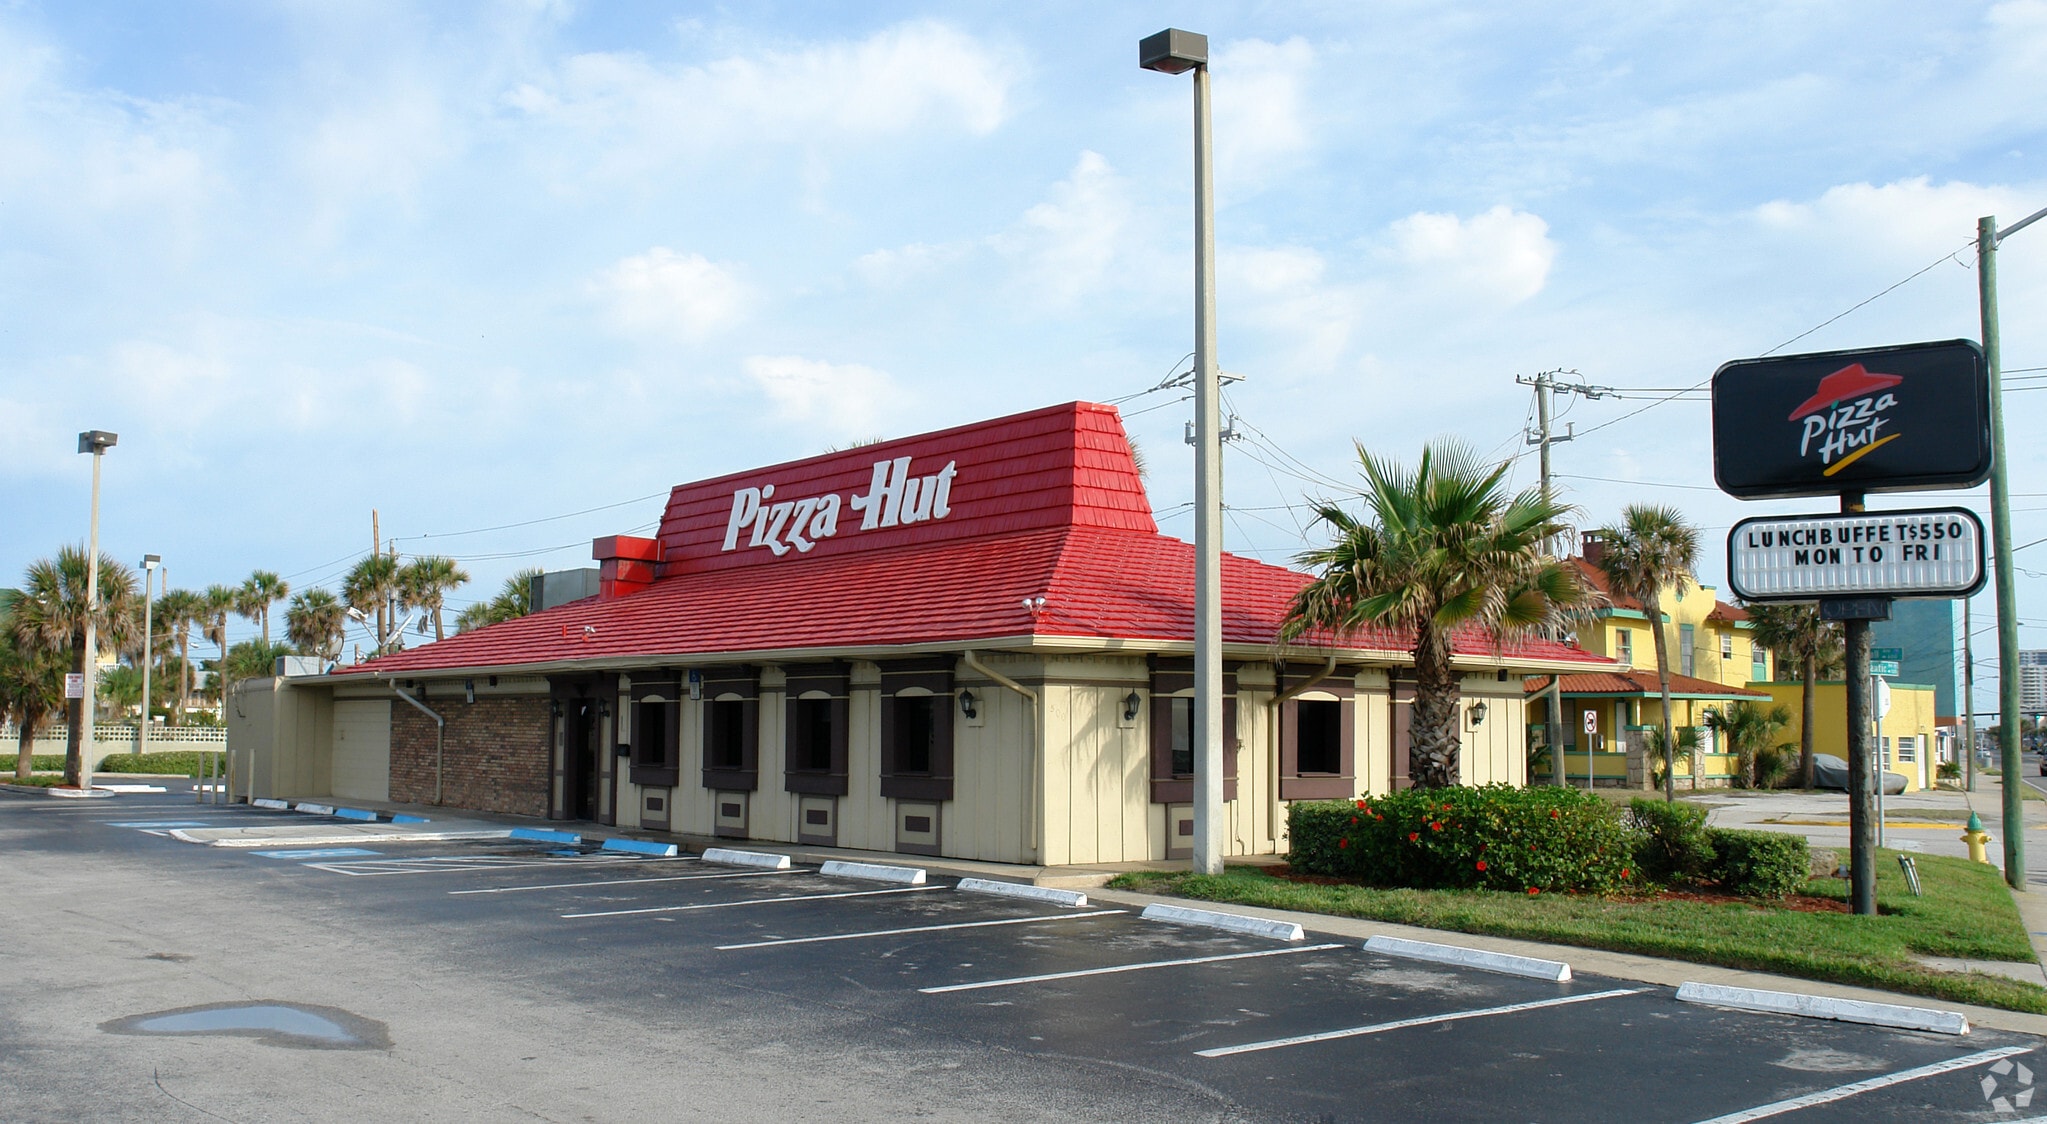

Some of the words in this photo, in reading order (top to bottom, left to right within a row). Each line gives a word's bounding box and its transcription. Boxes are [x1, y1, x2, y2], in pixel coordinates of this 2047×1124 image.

[1801, 393, 1898, 456] Pizza
[1818, 417, 1890, 464] Hut
[721, 484, 841, 556] Pizza
[851, 456, 957, 530] Hut
[1795, 548, 1840, 566] MON
[1853, 546, 1883, 563] TO
[1903, 544, 1940, 561] FRI
[1823, 601, 1884, 619] OPEN
